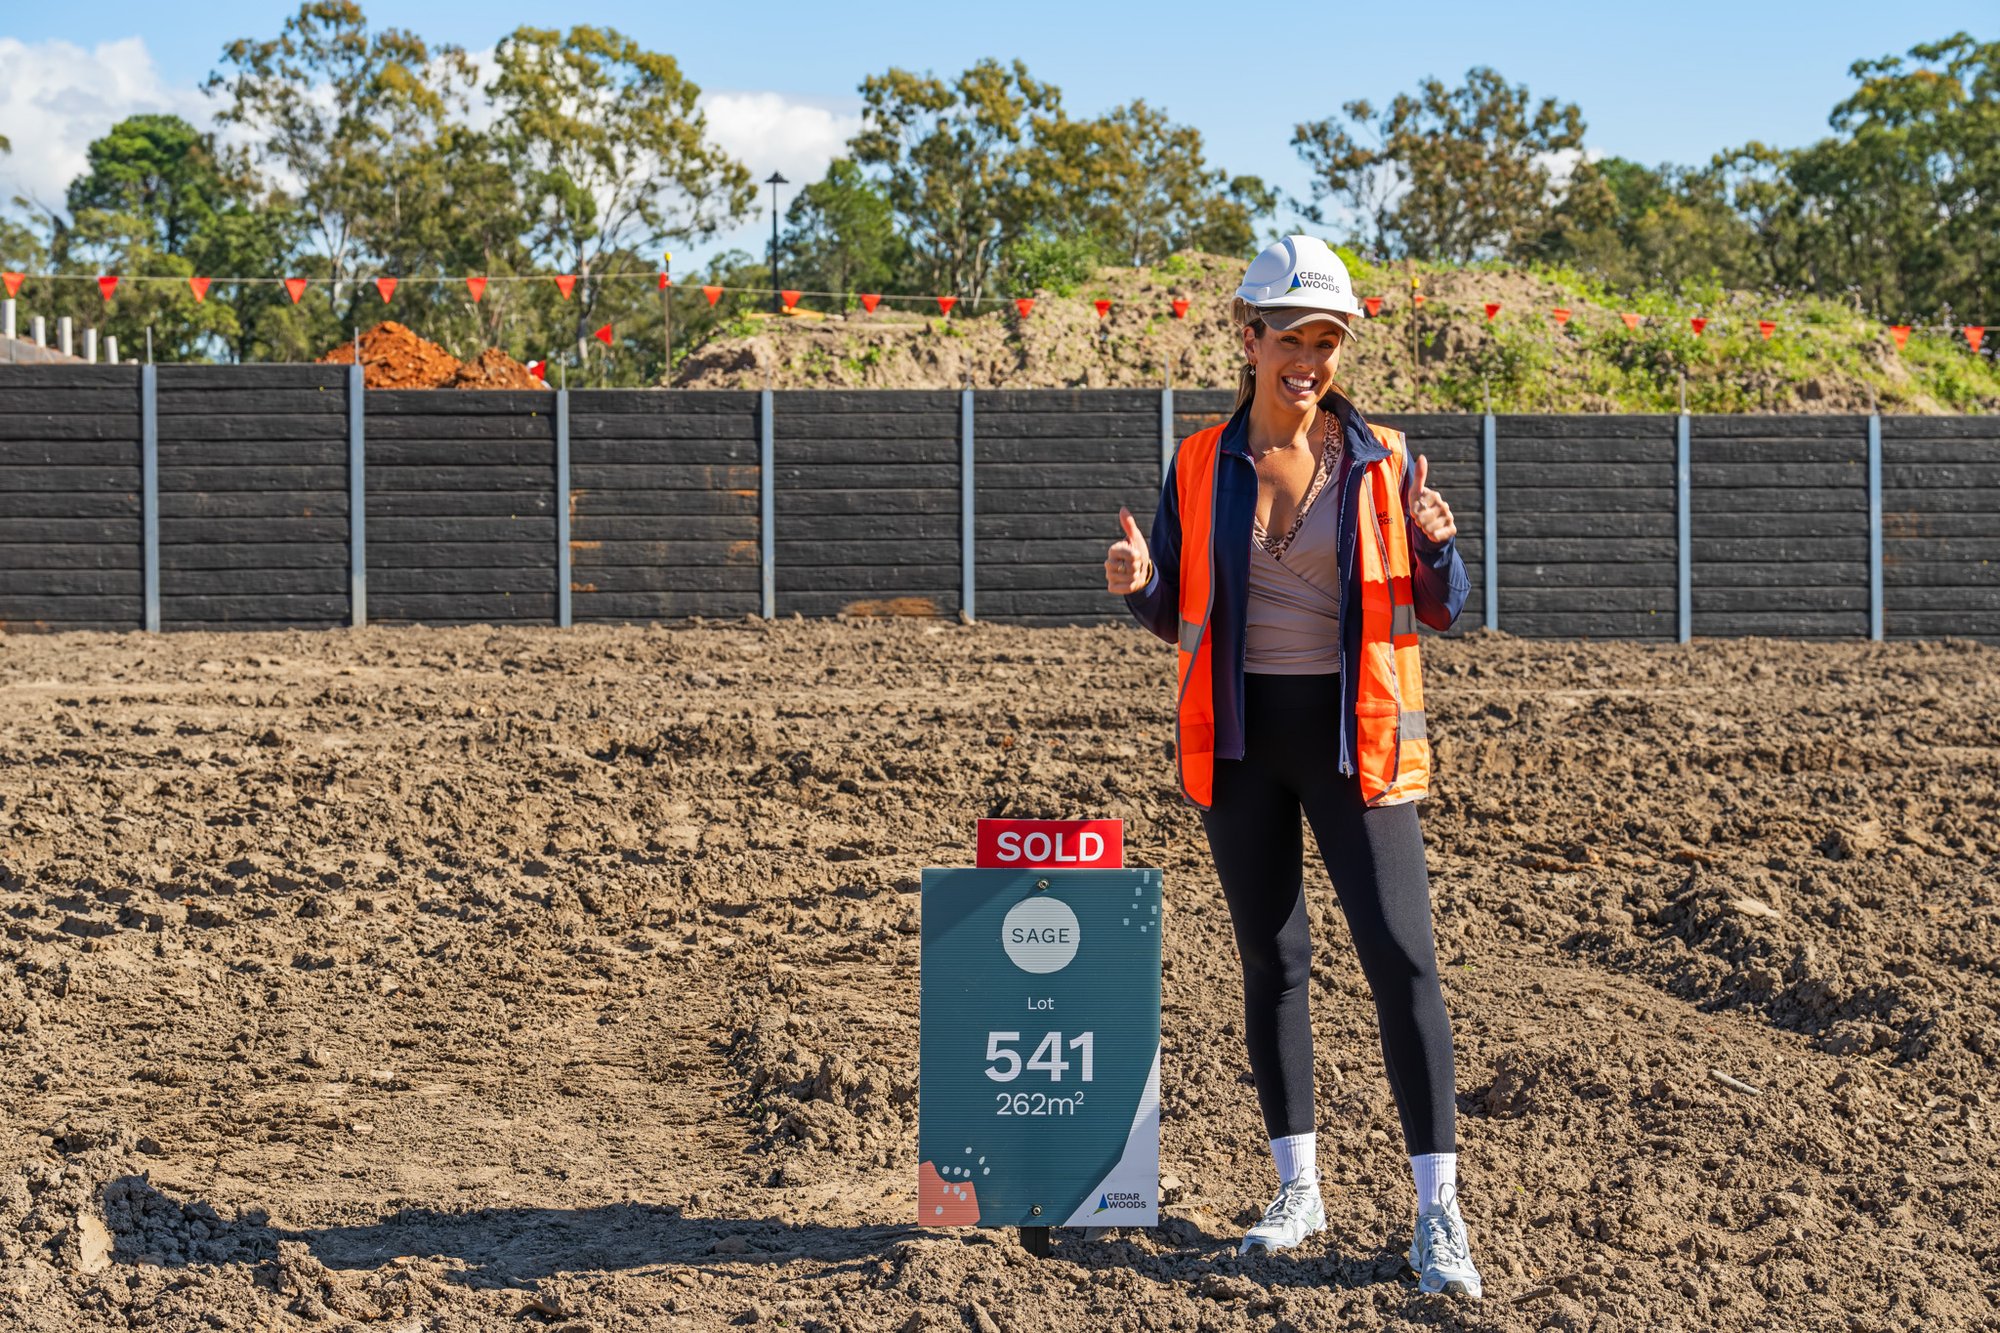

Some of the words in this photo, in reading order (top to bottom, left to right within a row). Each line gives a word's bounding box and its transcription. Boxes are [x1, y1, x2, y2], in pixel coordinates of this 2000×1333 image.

[1299, 271, 1334, 283] CEDAR
[1301, 280, 1340, 294] WOODS
[996, 831, 1105, 862] SOLD
[1011, 928, 1070, 943] SAGE
[1027, 996, 1054, 1010] Lot
[984, 1031, 1094, 1082] 541
[1106, 1192, 1140, 1201] CEDAR
[1108, 1200, 1147, 1209] WOODS
